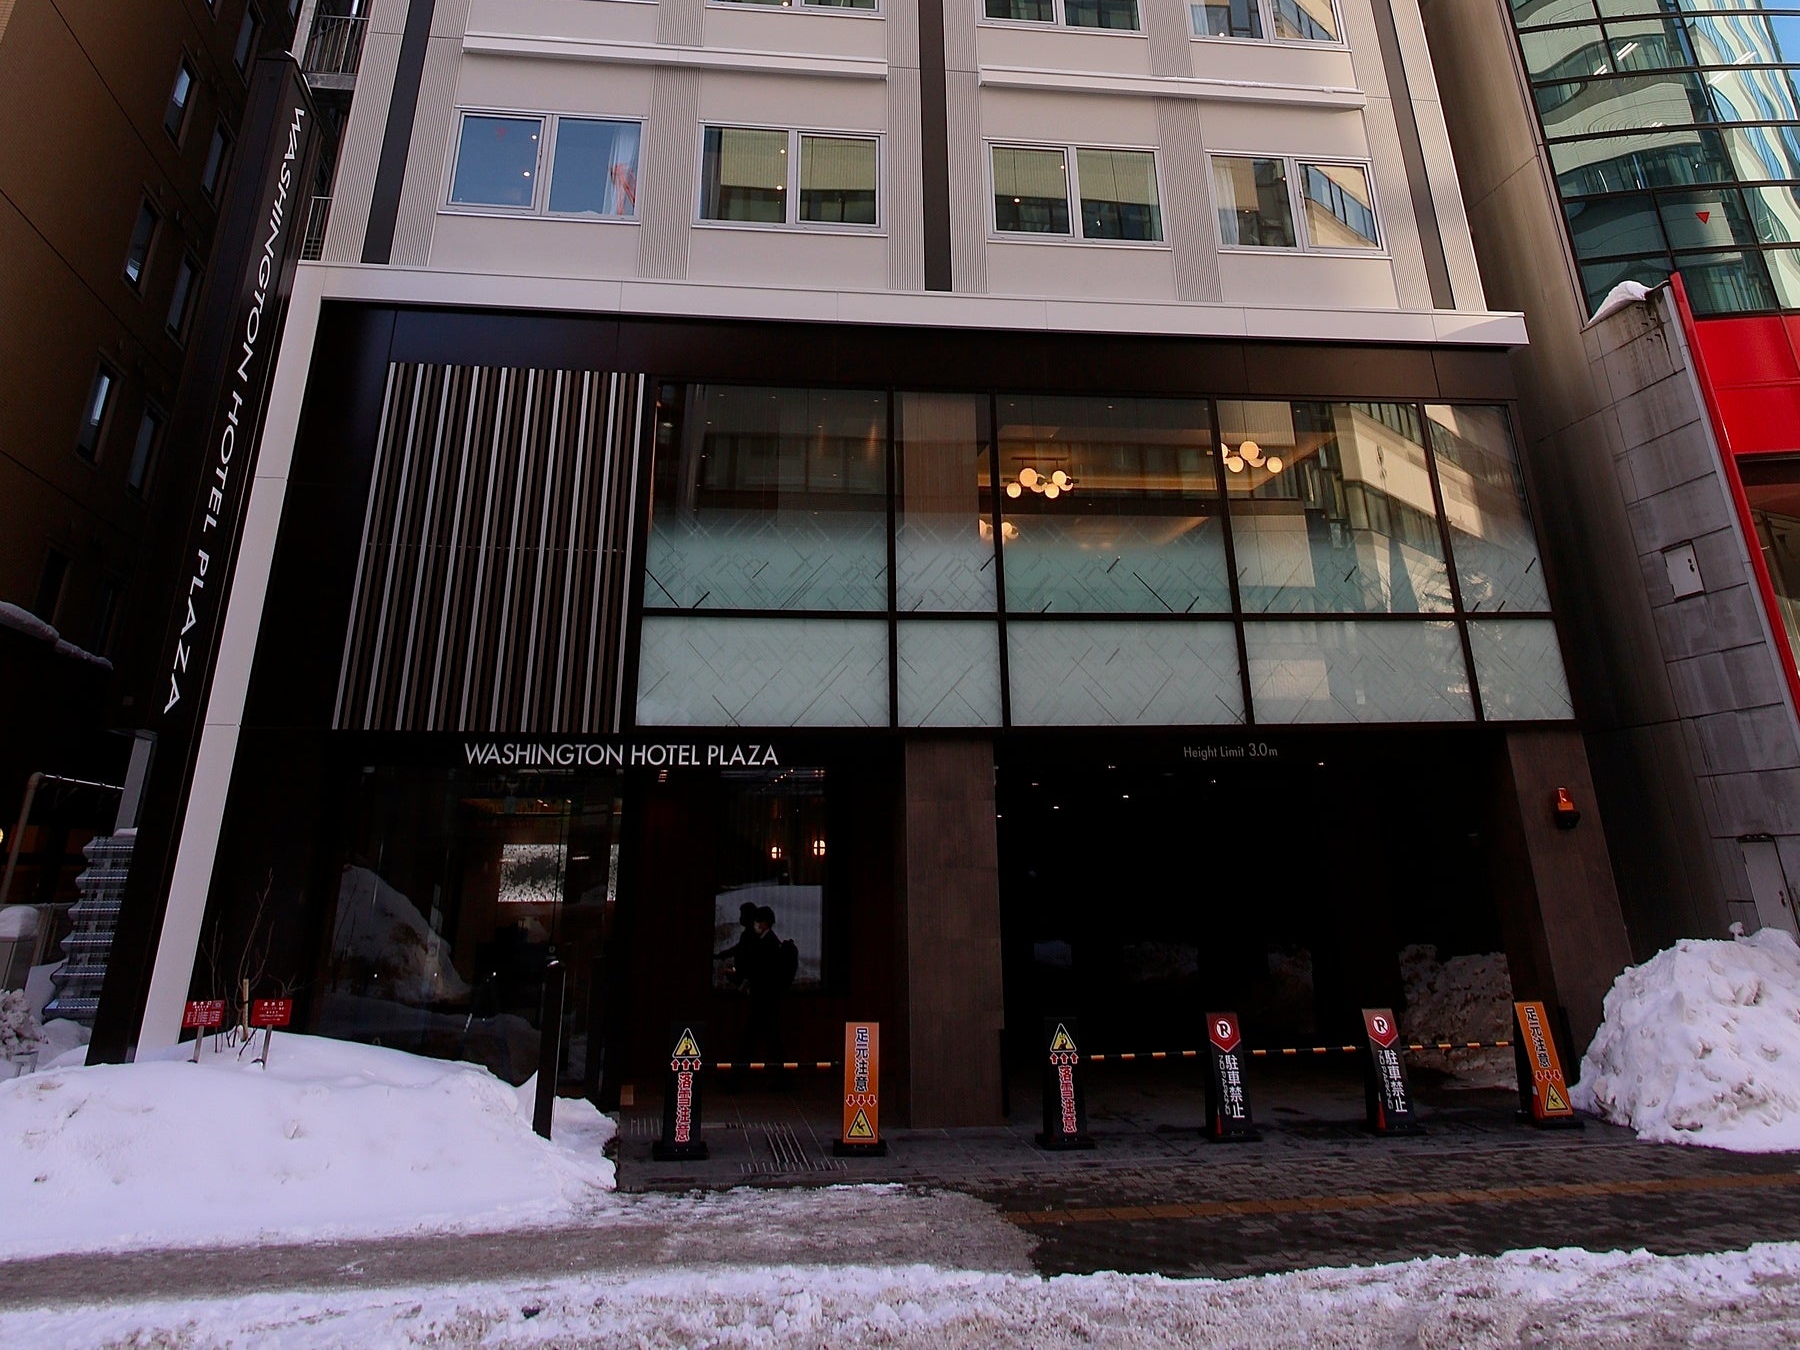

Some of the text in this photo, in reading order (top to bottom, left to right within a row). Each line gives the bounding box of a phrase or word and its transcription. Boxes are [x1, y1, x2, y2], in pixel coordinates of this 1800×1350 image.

[162, 106, 306, 715] WASHINGTON HOTEL PLAZA
[464, 743, 779, 766] WASHINGTON HOTEL PLAZA
[1183, 742, 1278, 761] Height Limit 3.0m
[854, 1026, 869, 1093] 足元注意
[1524, 1005, 1552, 1069] 足元注意
[674, 1071, 694, 1143] 落雪注意
[1057, 1064, 1078, 1133] 落雪注意
[1225, 1054, 1246, 1119] 駐車禁止
[1384, 1049, 1408, 1113] 駐車禁止
